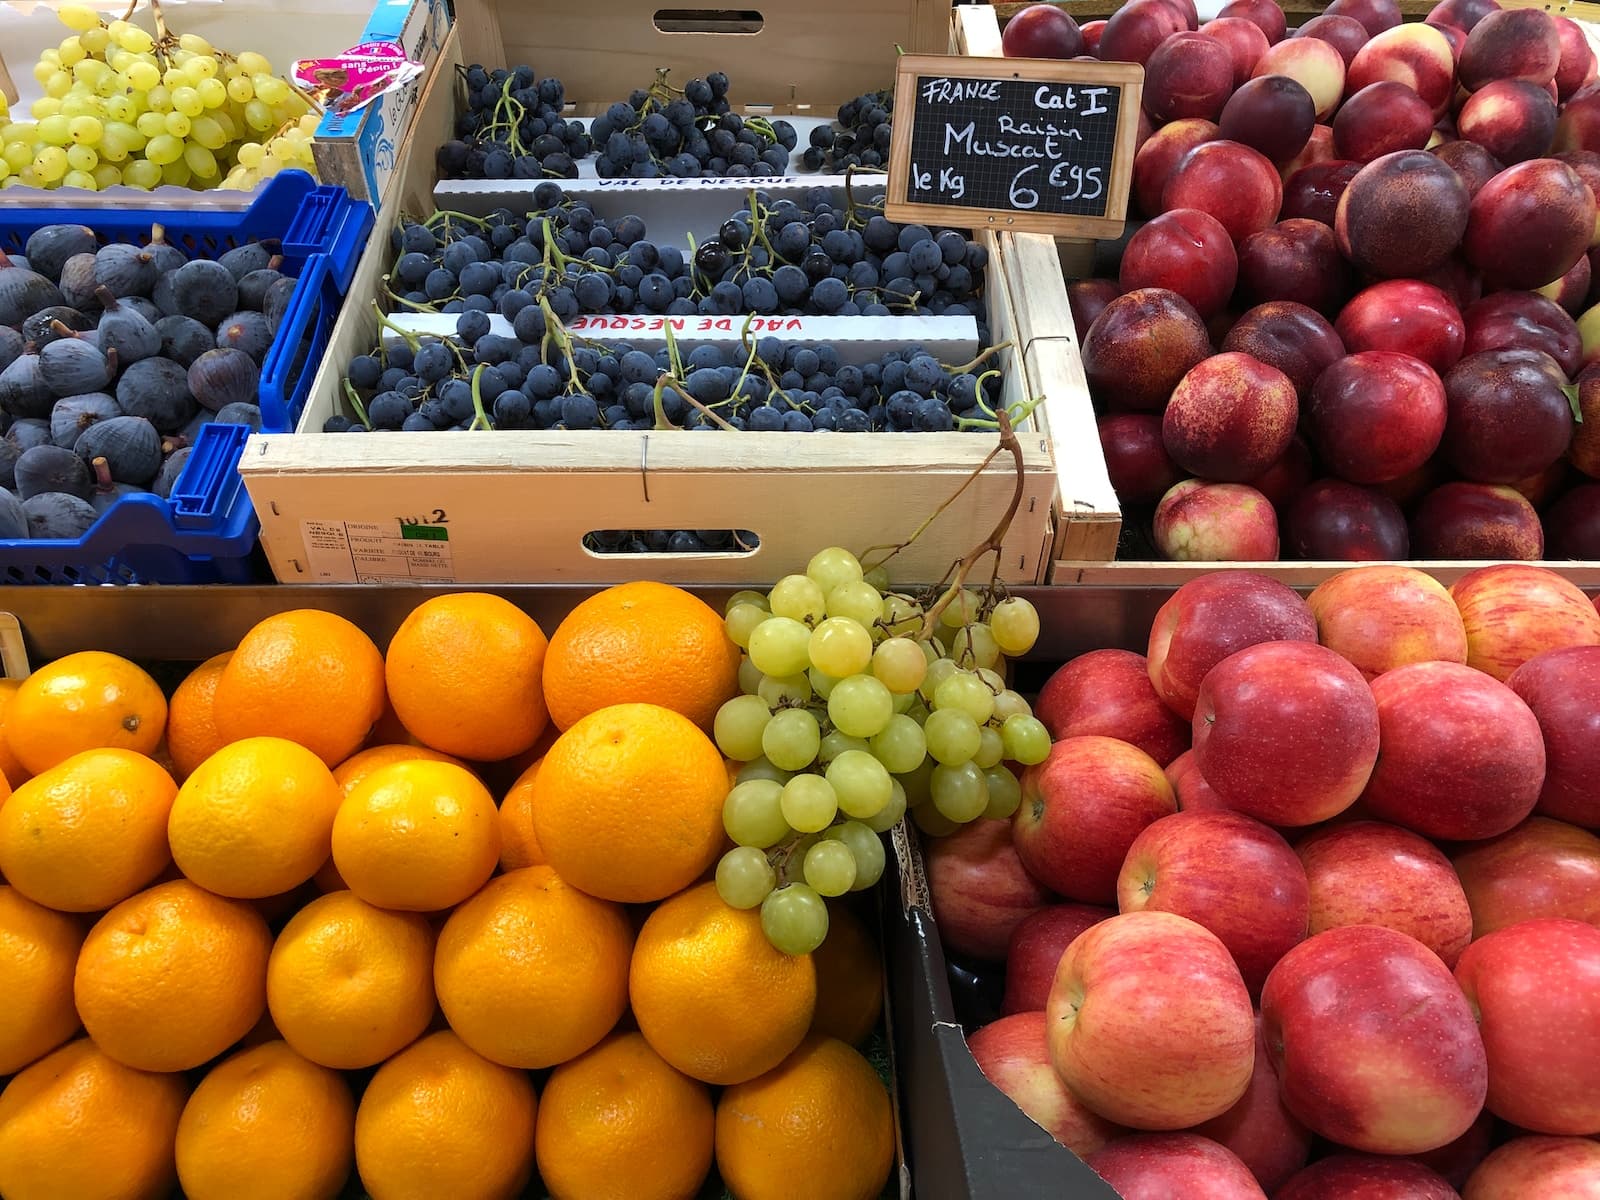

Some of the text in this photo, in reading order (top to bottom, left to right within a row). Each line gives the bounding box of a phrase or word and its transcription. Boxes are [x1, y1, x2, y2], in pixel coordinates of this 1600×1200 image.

[341, 61, 367, 69] sans
[358, 64, 390, 74] Pépin
[922, 78, 1002, 104] FRANCE
[1034, 85, 1078, 110] Cat
[998, 115, 1082, 140] Raisin
[943, 121, 1062, 160] Muscat
[913, 162, 932, 190] le
[940, 167, 965, 199] Kg
[571, 317, 802, 331] VAL DE NESQUE
